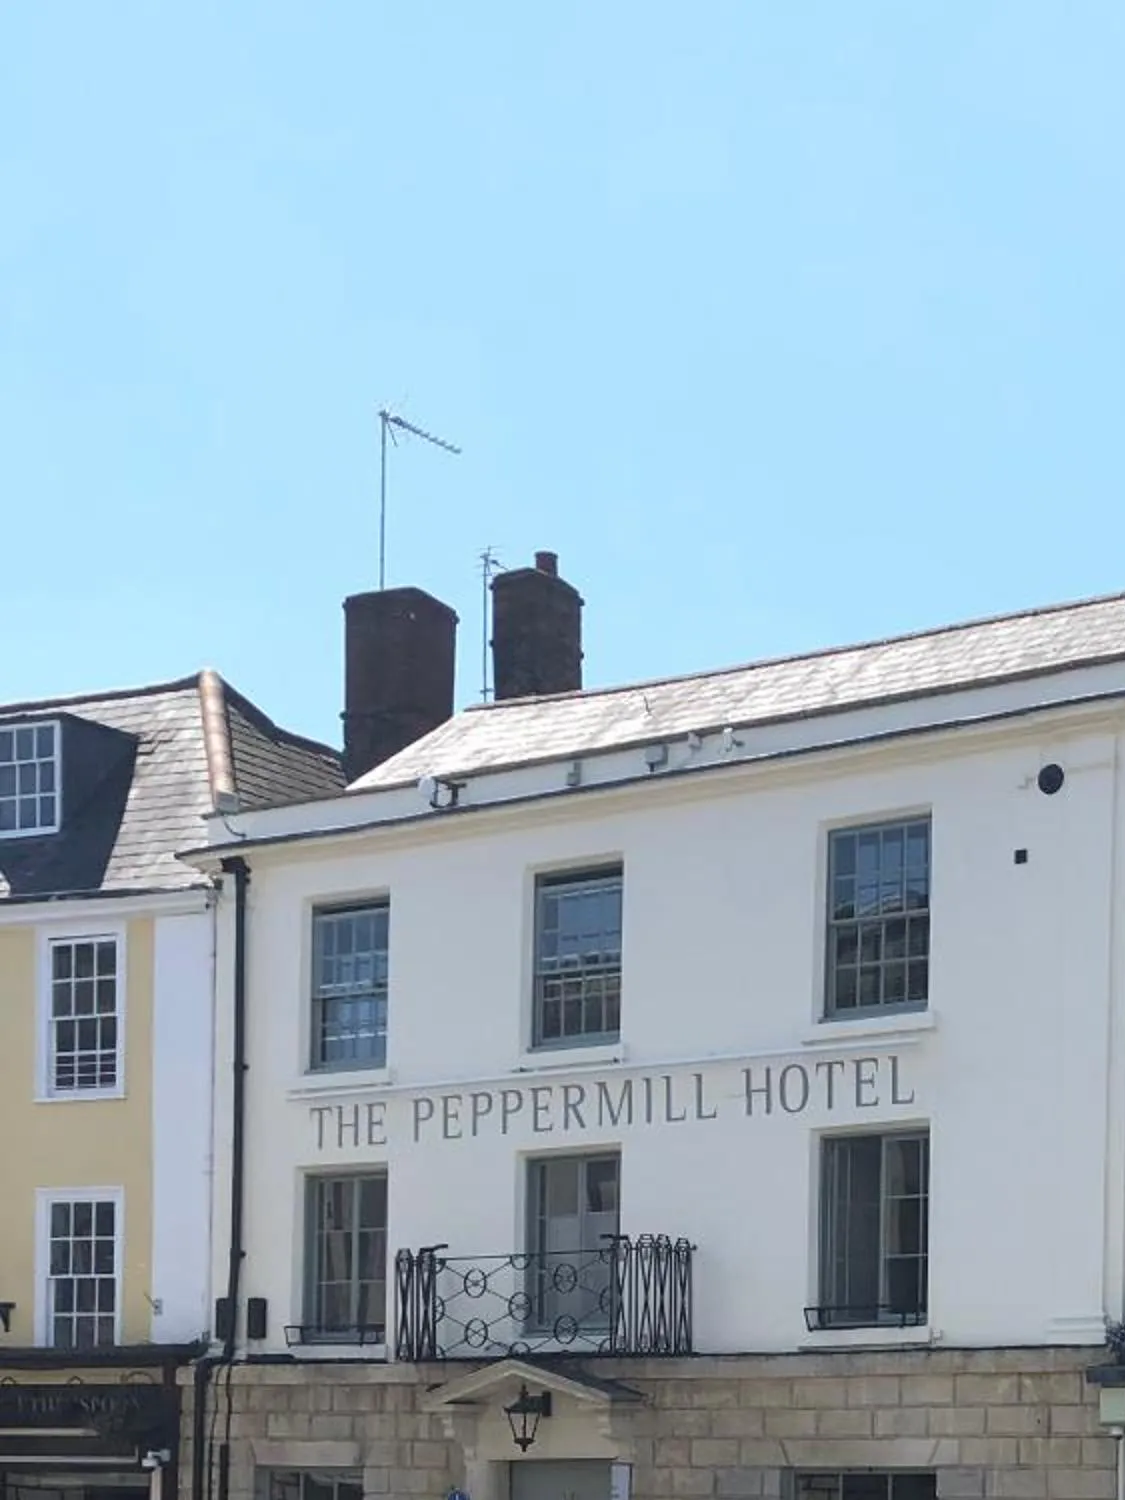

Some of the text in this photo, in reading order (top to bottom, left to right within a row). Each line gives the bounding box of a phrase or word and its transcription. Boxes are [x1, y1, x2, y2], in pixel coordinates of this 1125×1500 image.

[309, 1054, 916, 1150] THE PEPPERMILL HOTEL
